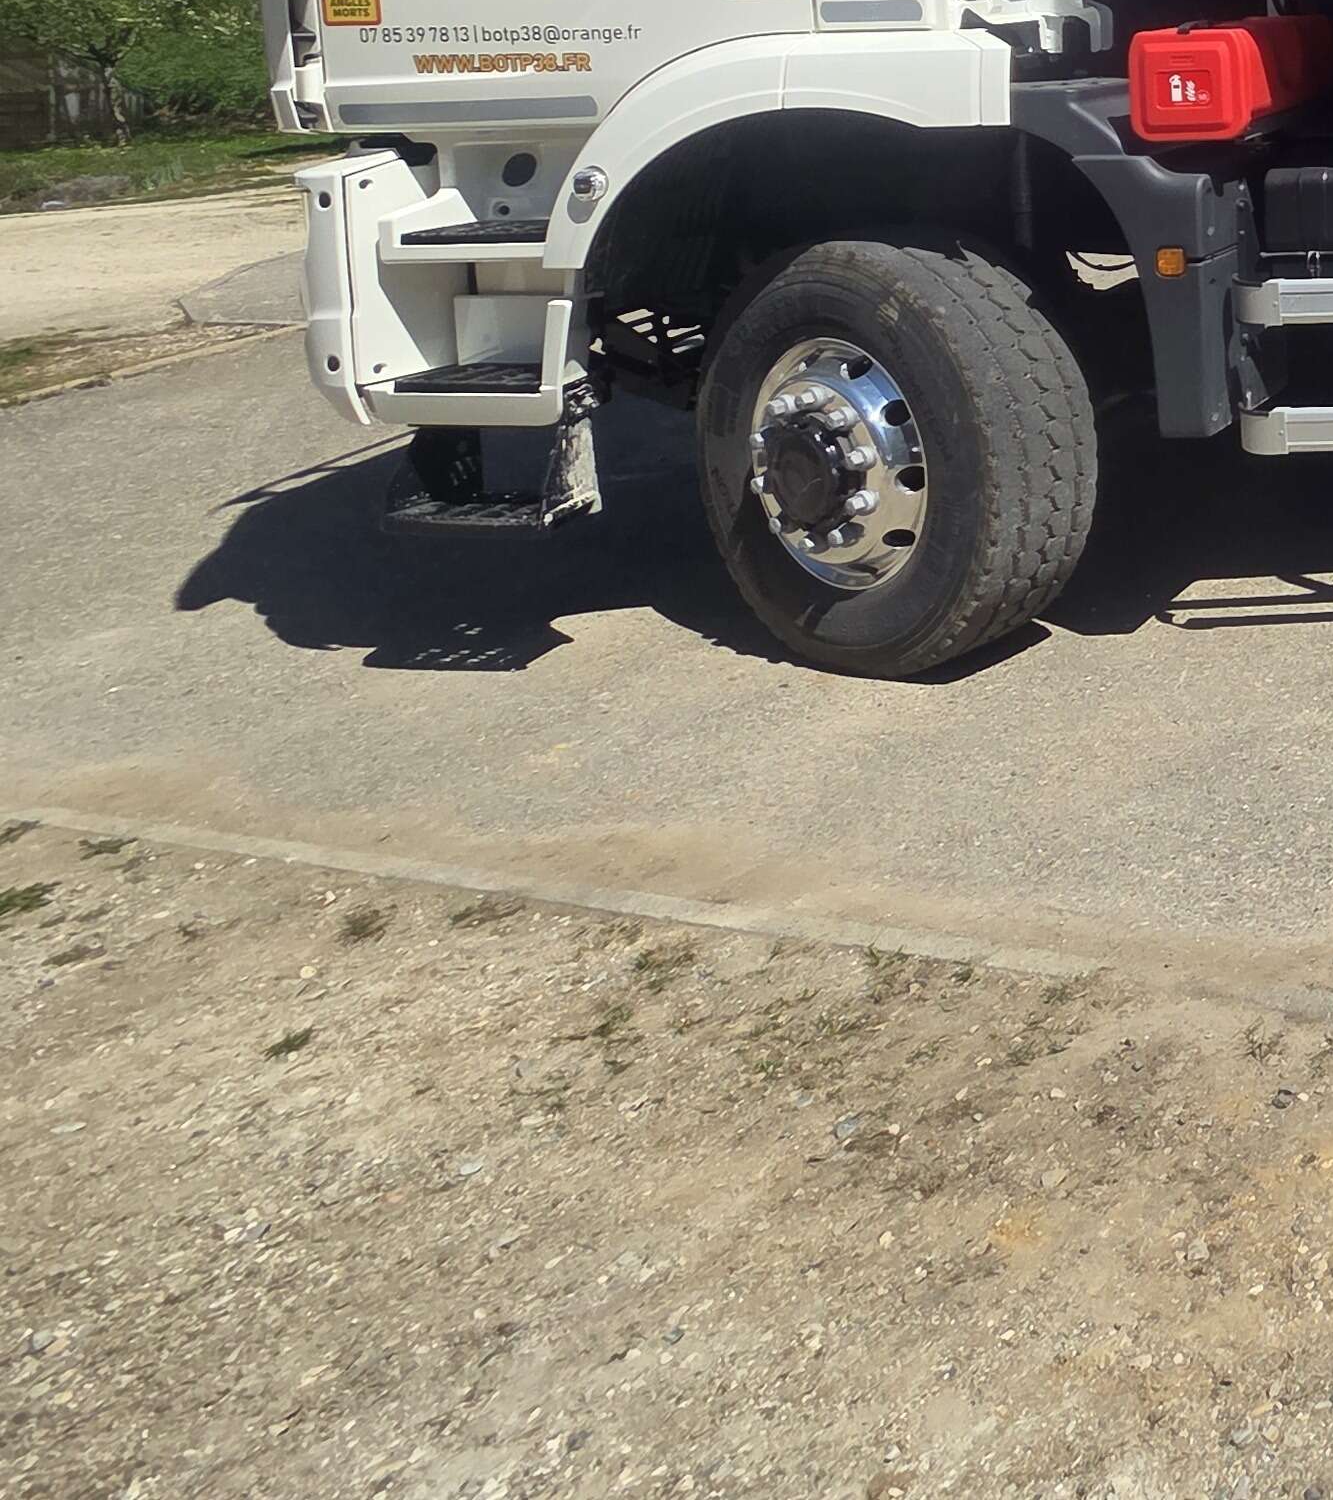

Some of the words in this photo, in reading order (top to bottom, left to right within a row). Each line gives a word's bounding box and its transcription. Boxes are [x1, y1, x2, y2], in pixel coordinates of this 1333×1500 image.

[333, 8, 370, 17] MORTS
[359, 28, 377, 43] 07
[382, 27, 401, 43] 85
[406, 27, 425, 42] 39
[429, 26, 450, 42] 78
[482, 24, 642, 45] botp38@orange.fr
[414, 52, 592, 73] WWW.BOTP38.FR
